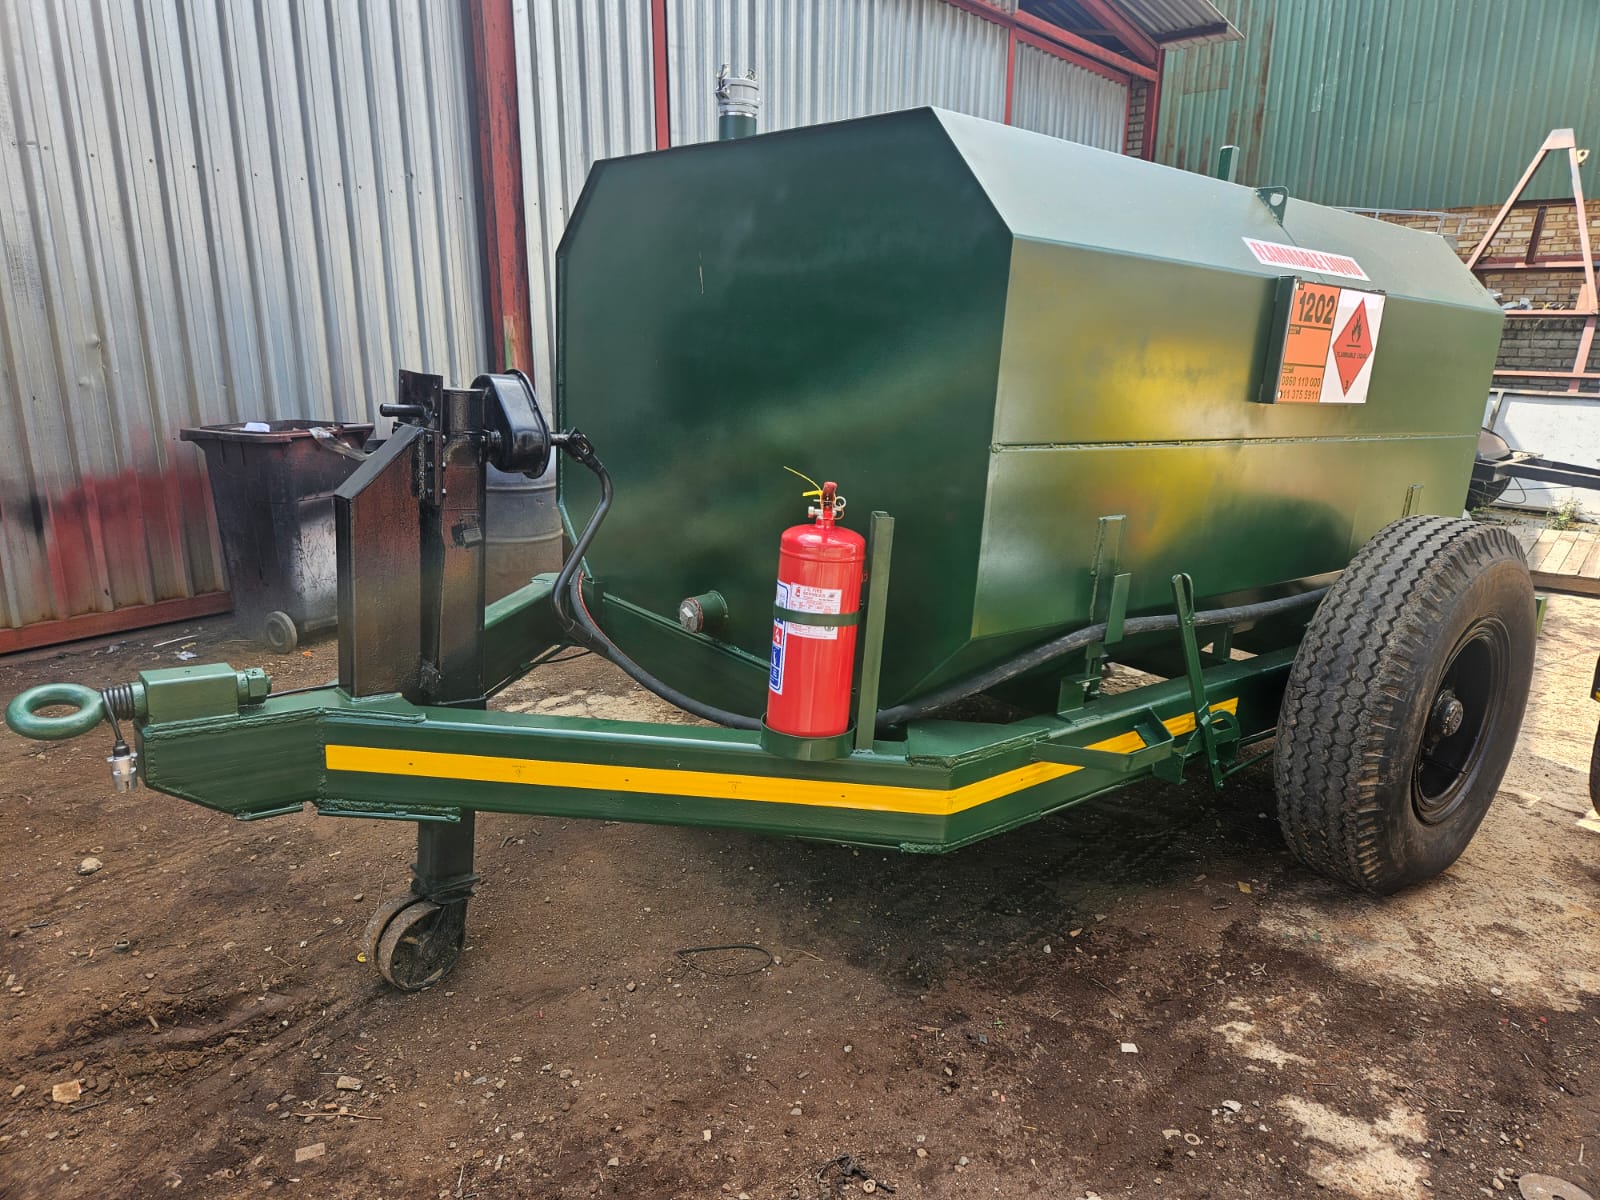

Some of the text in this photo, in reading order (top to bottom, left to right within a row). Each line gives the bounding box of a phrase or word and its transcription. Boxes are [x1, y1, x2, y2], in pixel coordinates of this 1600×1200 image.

[1249, 241, 1328, 270] FLAMMABLE
[1298, 291, 1336, 325] 1202
[1291, 389, 1303, 400] 375
